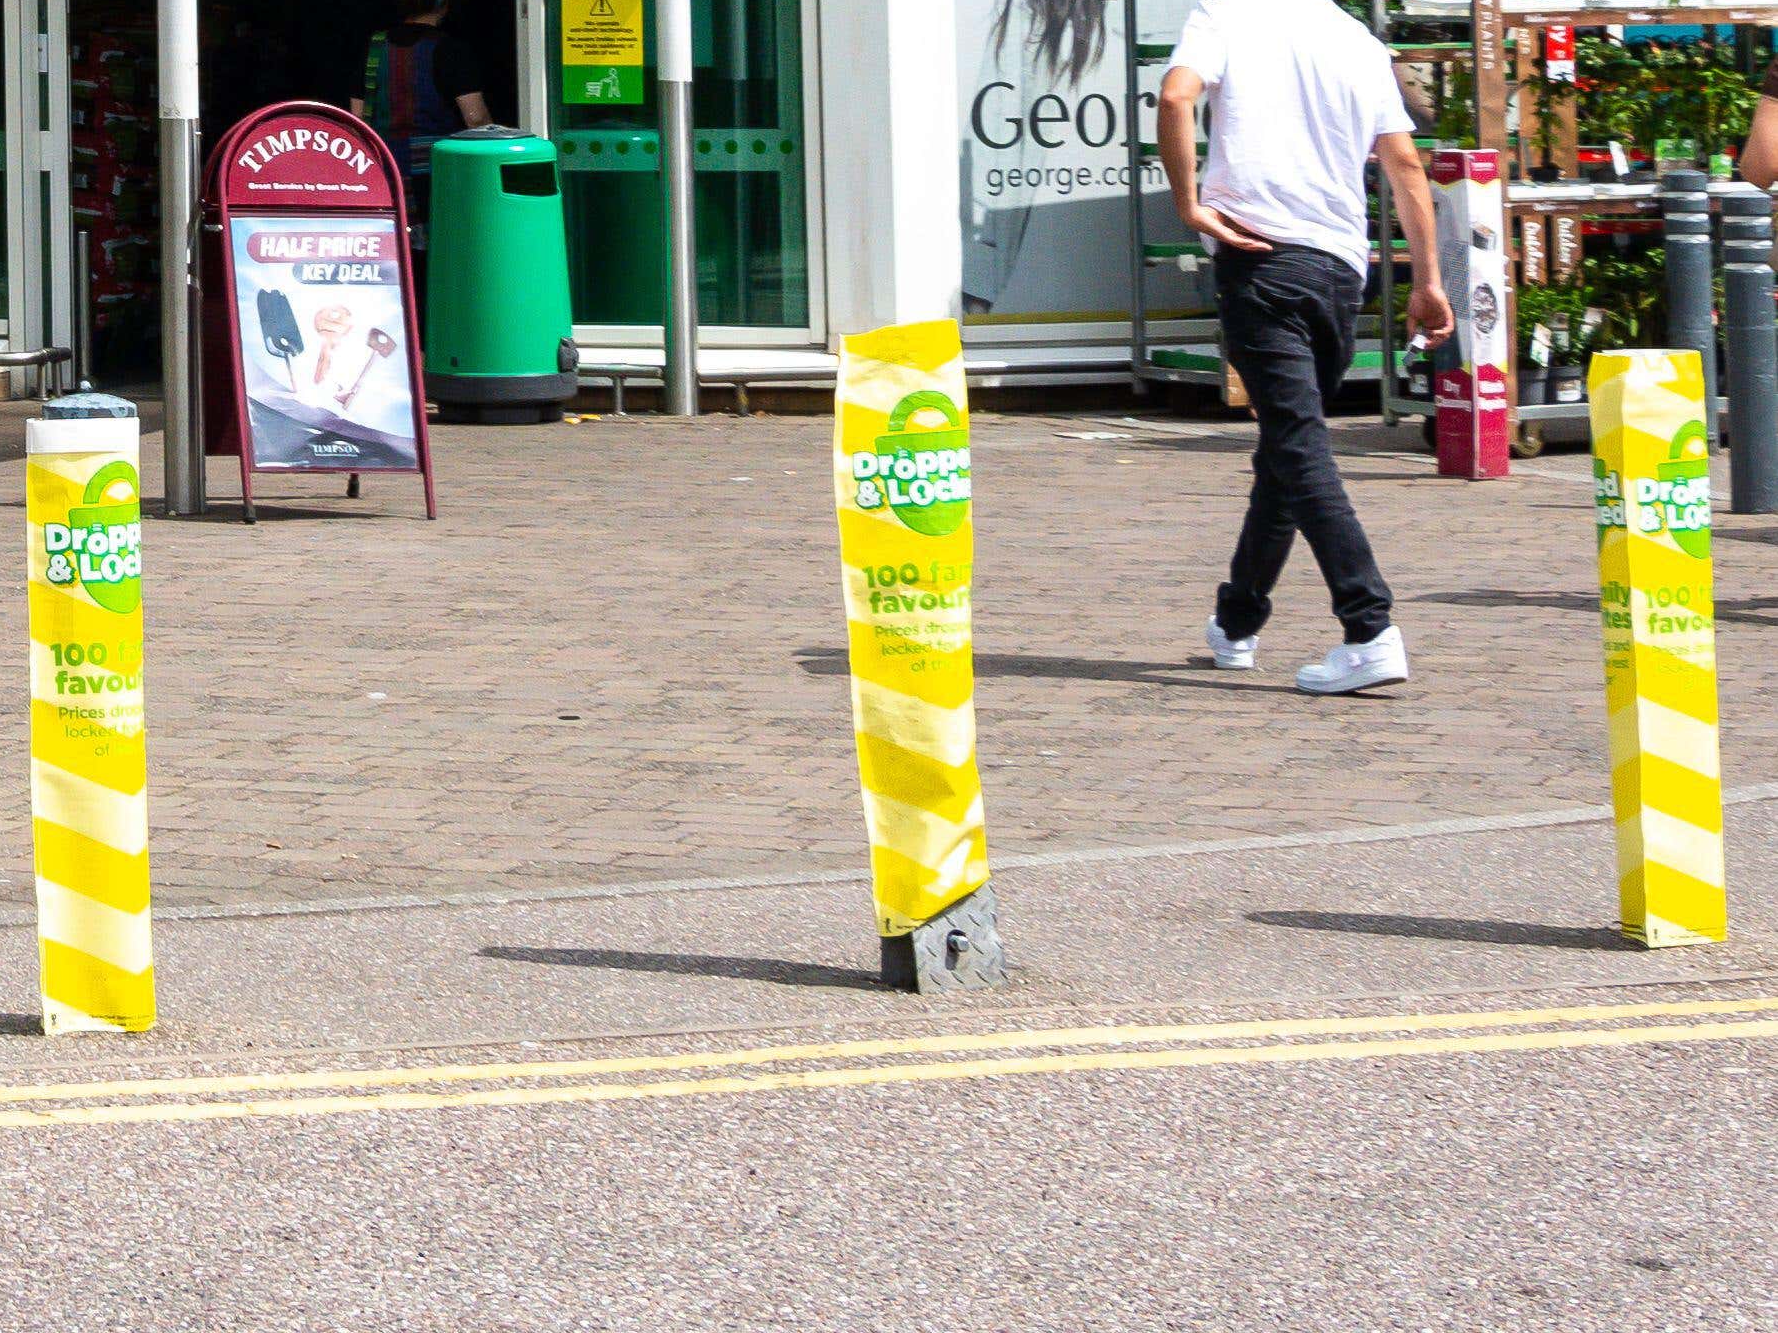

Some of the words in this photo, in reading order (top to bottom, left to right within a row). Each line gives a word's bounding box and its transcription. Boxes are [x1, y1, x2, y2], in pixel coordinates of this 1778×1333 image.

[1480, 11, 1496, 70] PLANTS
[238, 129, 375, 175] TIMPSON
[259, 236, 316, 259] HALF
[317, 236, 382, 258] PRICE
[301, 263, 337, 282] KEY
[338, 263, 382, 282] DEAL
[311, 443, 361, 455] TIMPSON
[856, 479, 882, 508] &
[47, 553, 74, 582] &
[862, 563, 920, 588] 100
[1645, 586, 1691, 609] 100
[50, 643, 107, 666] 100
[58, 706, 105, 720] Prices
[95, 742, 109, 757] of
